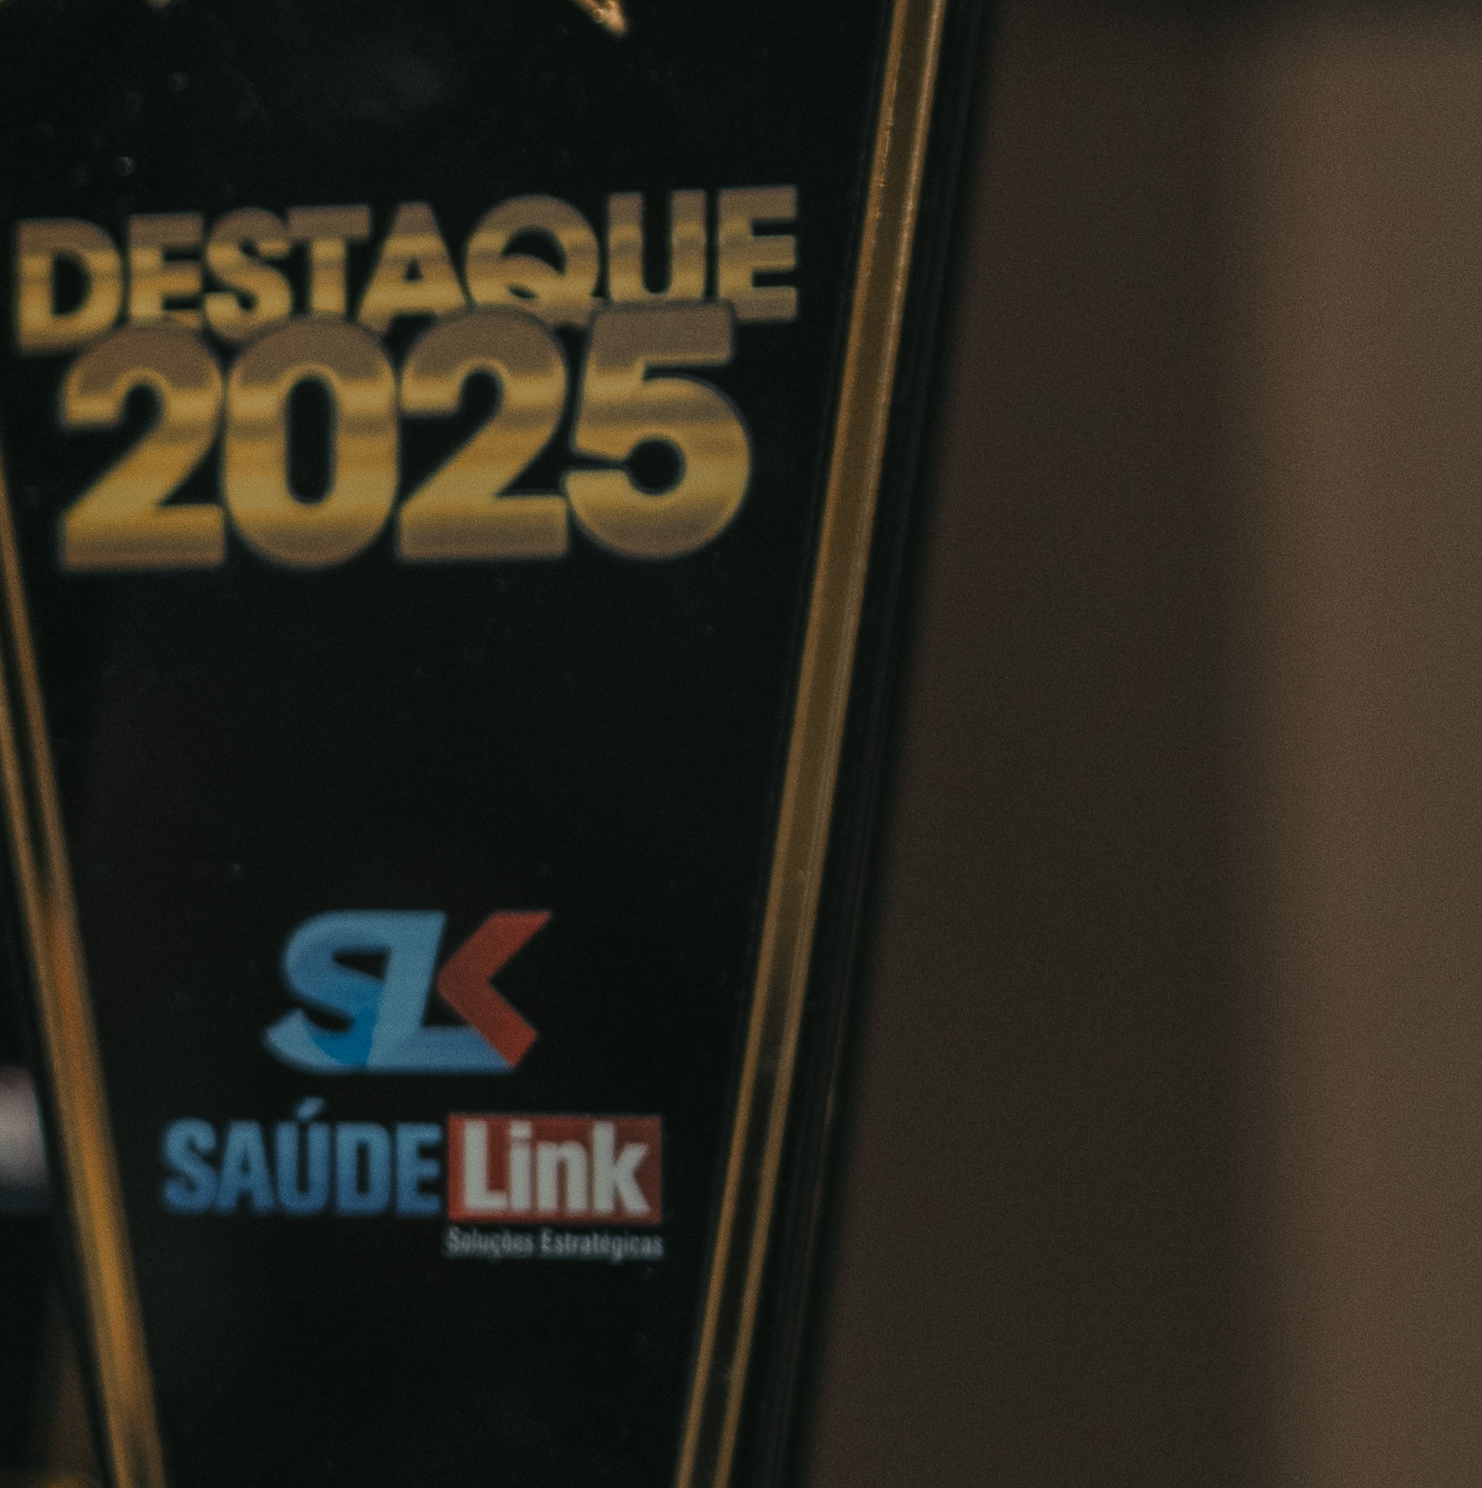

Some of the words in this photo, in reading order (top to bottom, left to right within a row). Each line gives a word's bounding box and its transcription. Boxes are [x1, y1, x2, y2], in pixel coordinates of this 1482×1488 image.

[17, 185, 798, 355] DESTAQUE
[61, 298, 751, 570] 2025
[162, 1097, 442, 1217] SAÚDE
[463, 1121, 651, 1214] Link
[445, 1226, 534, 1262] Soluções
[540, 1228, 664, 1263] Estratégicas
